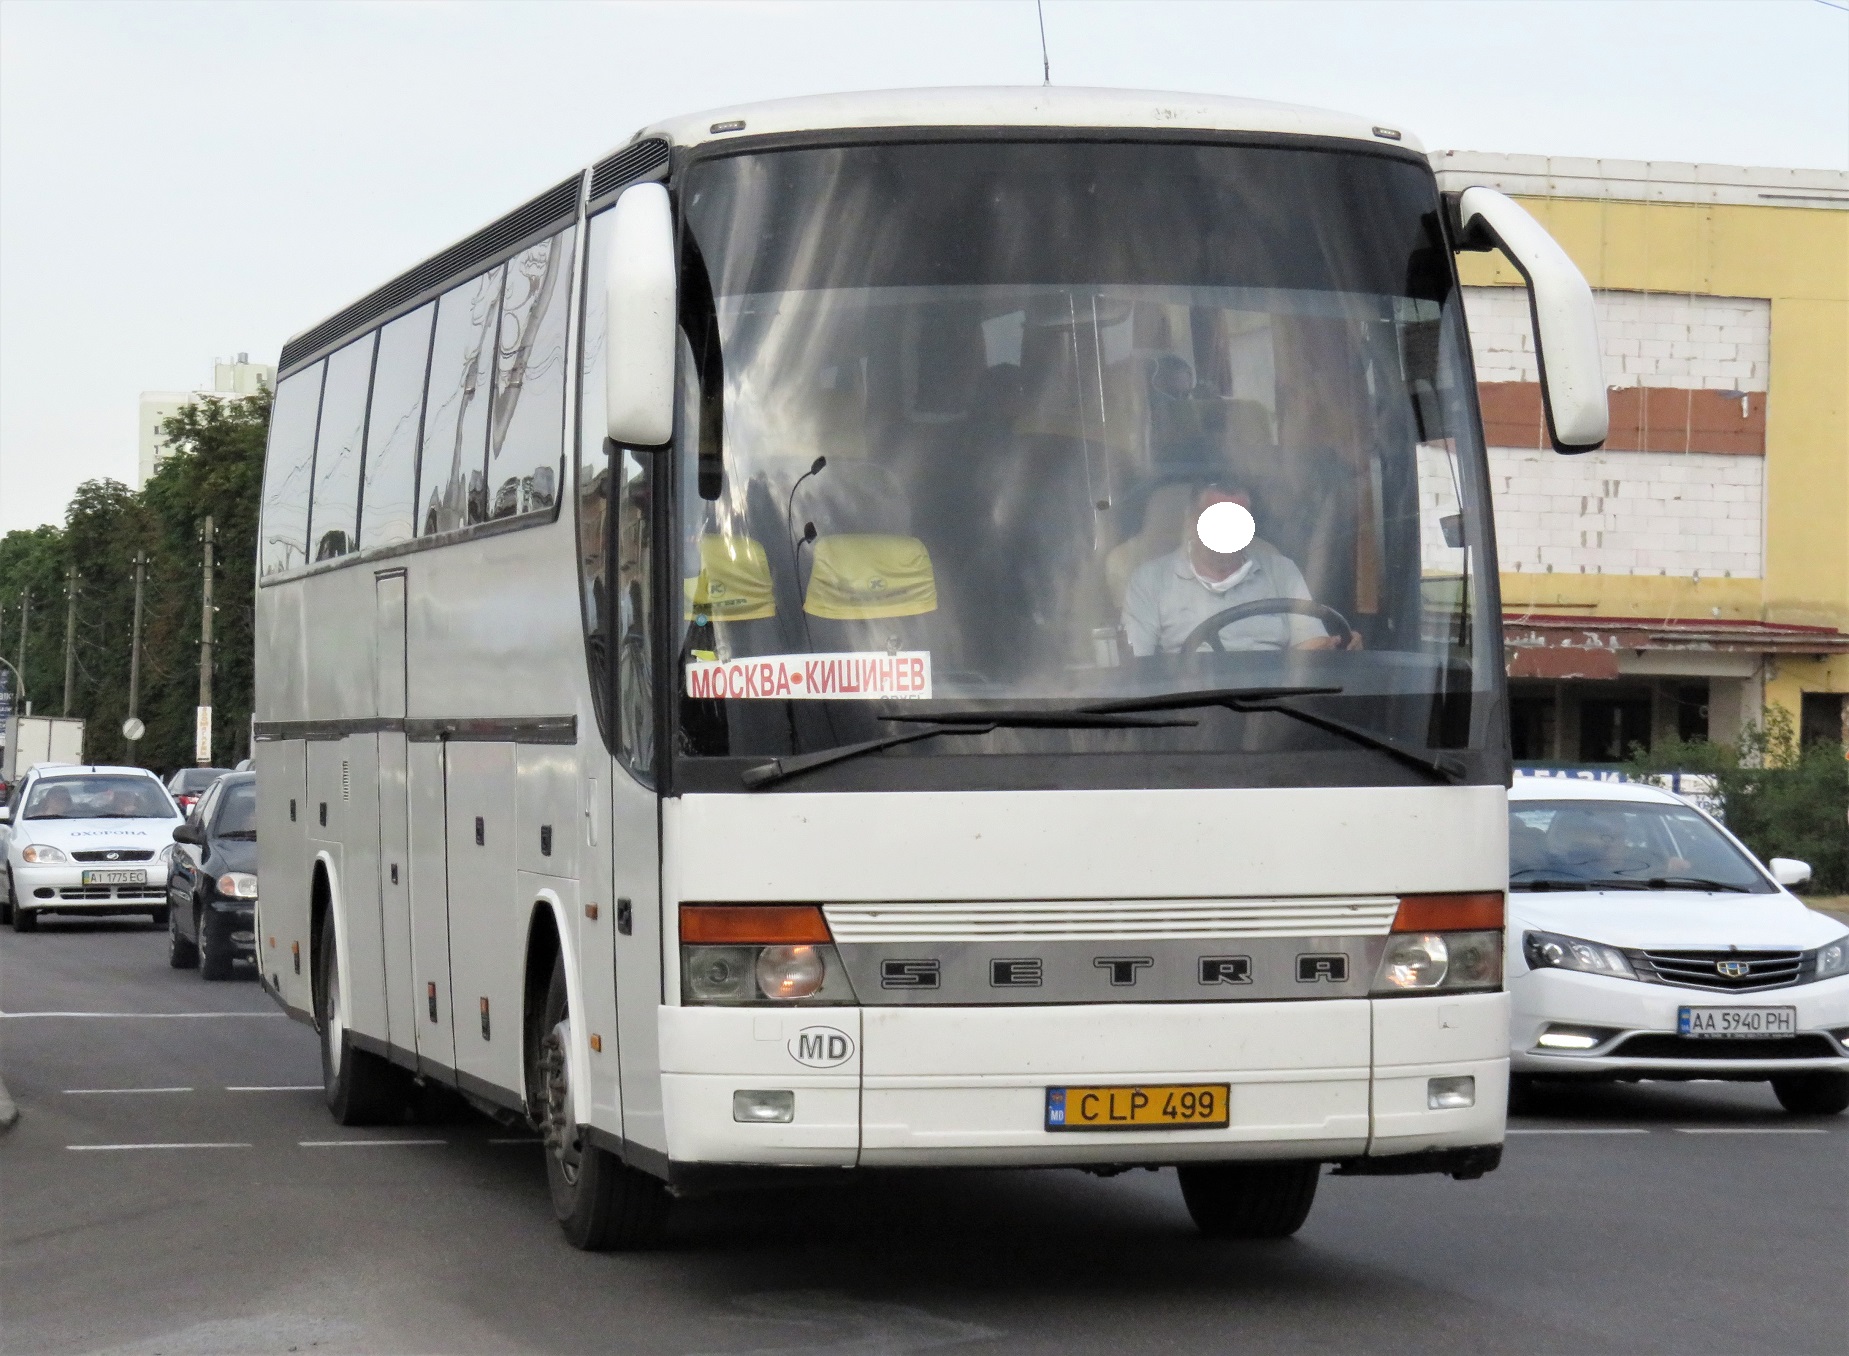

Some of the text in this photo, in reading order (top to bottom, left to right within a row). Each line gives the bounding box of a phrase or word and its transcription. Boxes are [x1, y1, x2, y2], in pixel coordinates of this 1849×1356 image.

[691, 658, 925, 698] МОСКВА КИШИНЕВ
[107, 873, 128, 883] 1775
[130, 872, 144, 882] EC
[880, 953, 1349, 989] SETRA
[1693, 1013, 1716, 1030] AA
[1722, 1013, 1761, 1030] 5940
[1766, 1013, 1790, 1030] PH
[798, 1033, 848, 1060] MD
[1050, 1091, 1214, 1121] MD CLP 499
